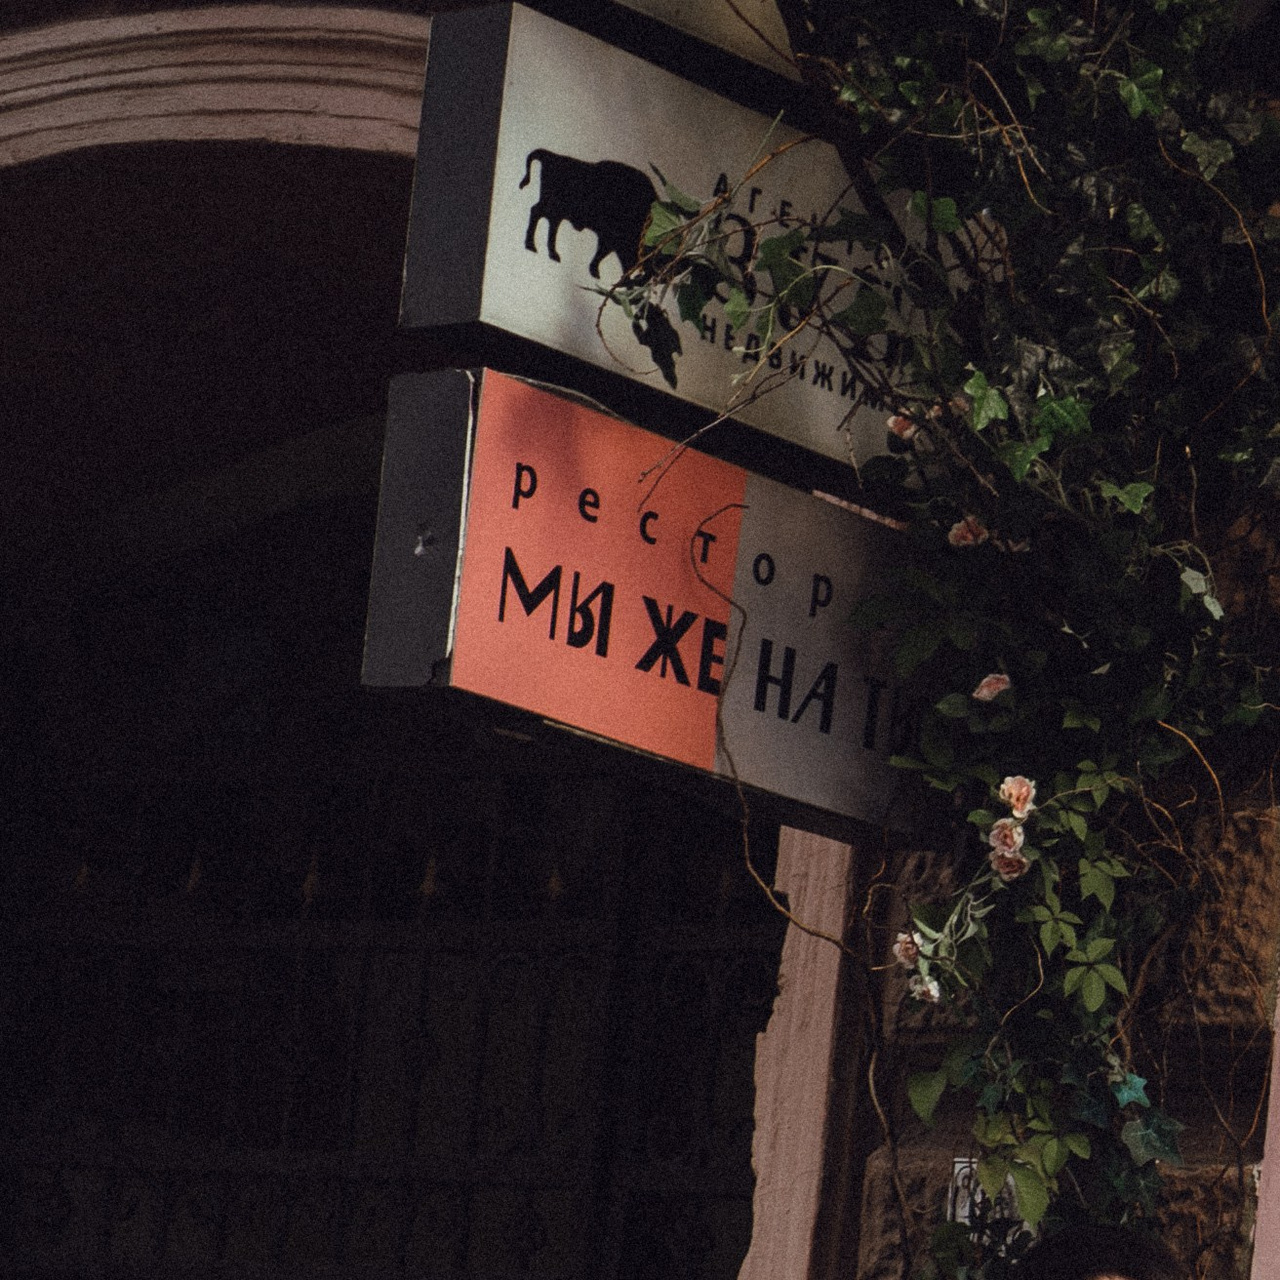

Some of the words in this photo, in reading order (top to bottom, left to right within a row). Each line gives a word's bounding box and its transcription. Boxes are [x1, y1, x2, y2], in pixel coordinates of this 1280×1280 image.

[498, 546, 614, 659] МЫ
[635, 596, 727, 696] ЖЕ
[753, 639, 839, 736] НА
